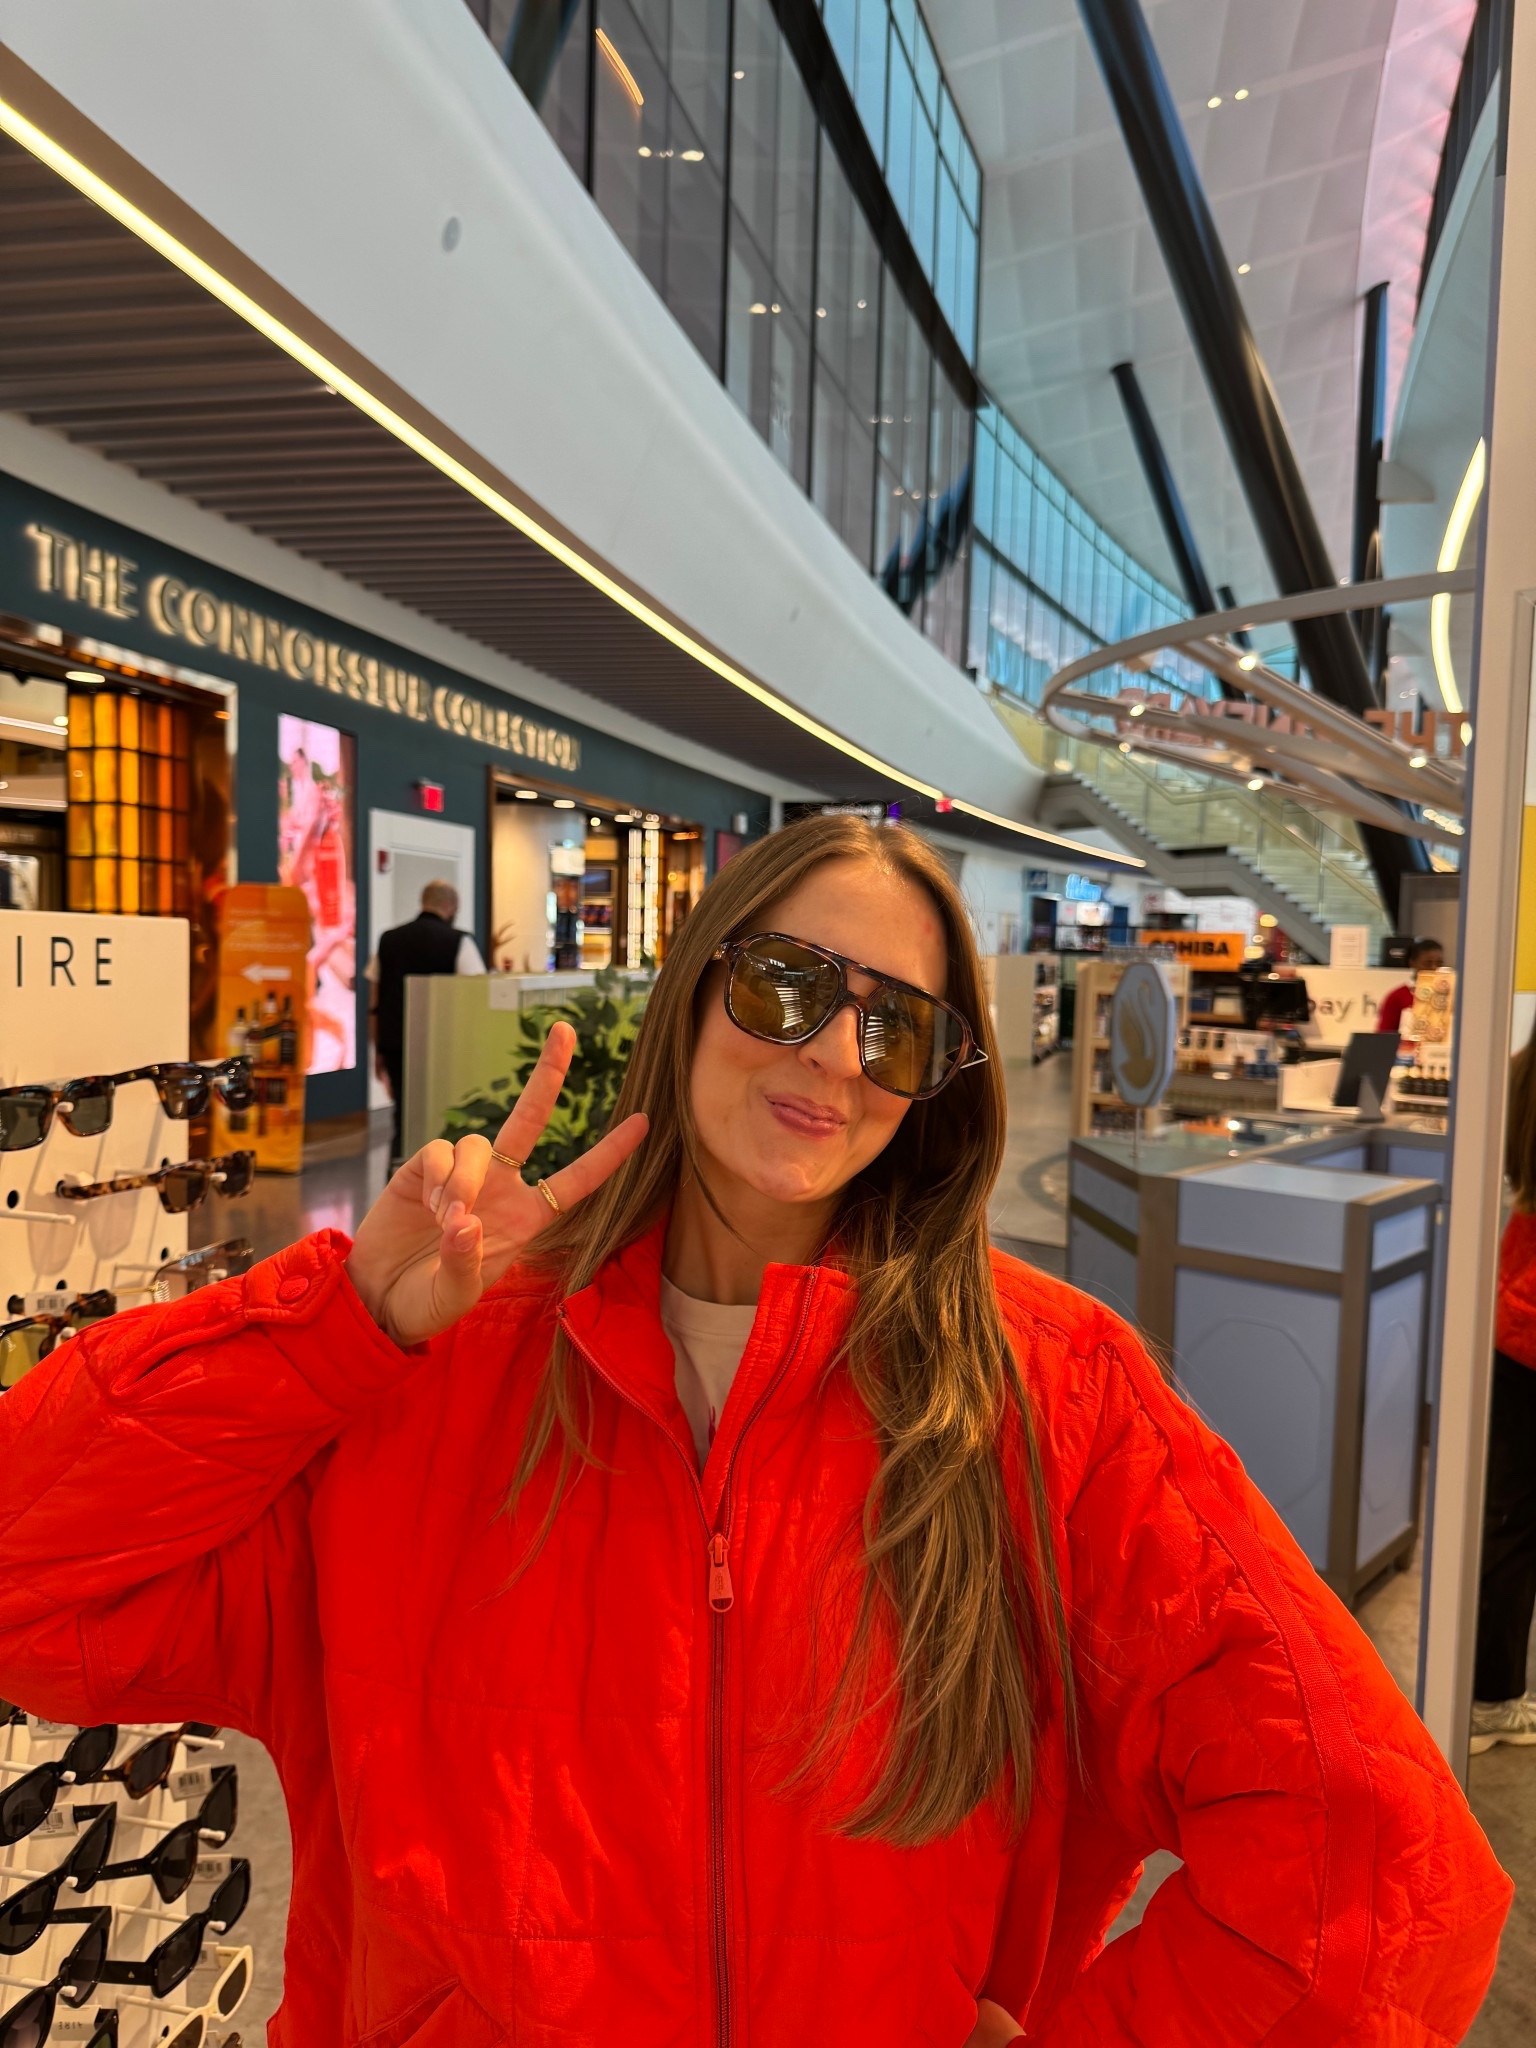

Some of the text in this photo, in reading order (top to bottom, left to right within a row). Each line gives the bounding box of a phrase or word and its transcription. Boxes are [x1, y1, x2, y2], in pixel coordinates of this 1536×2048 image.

[25, 522, 581, 772] THE CONNOISSEUR COLLECTION
